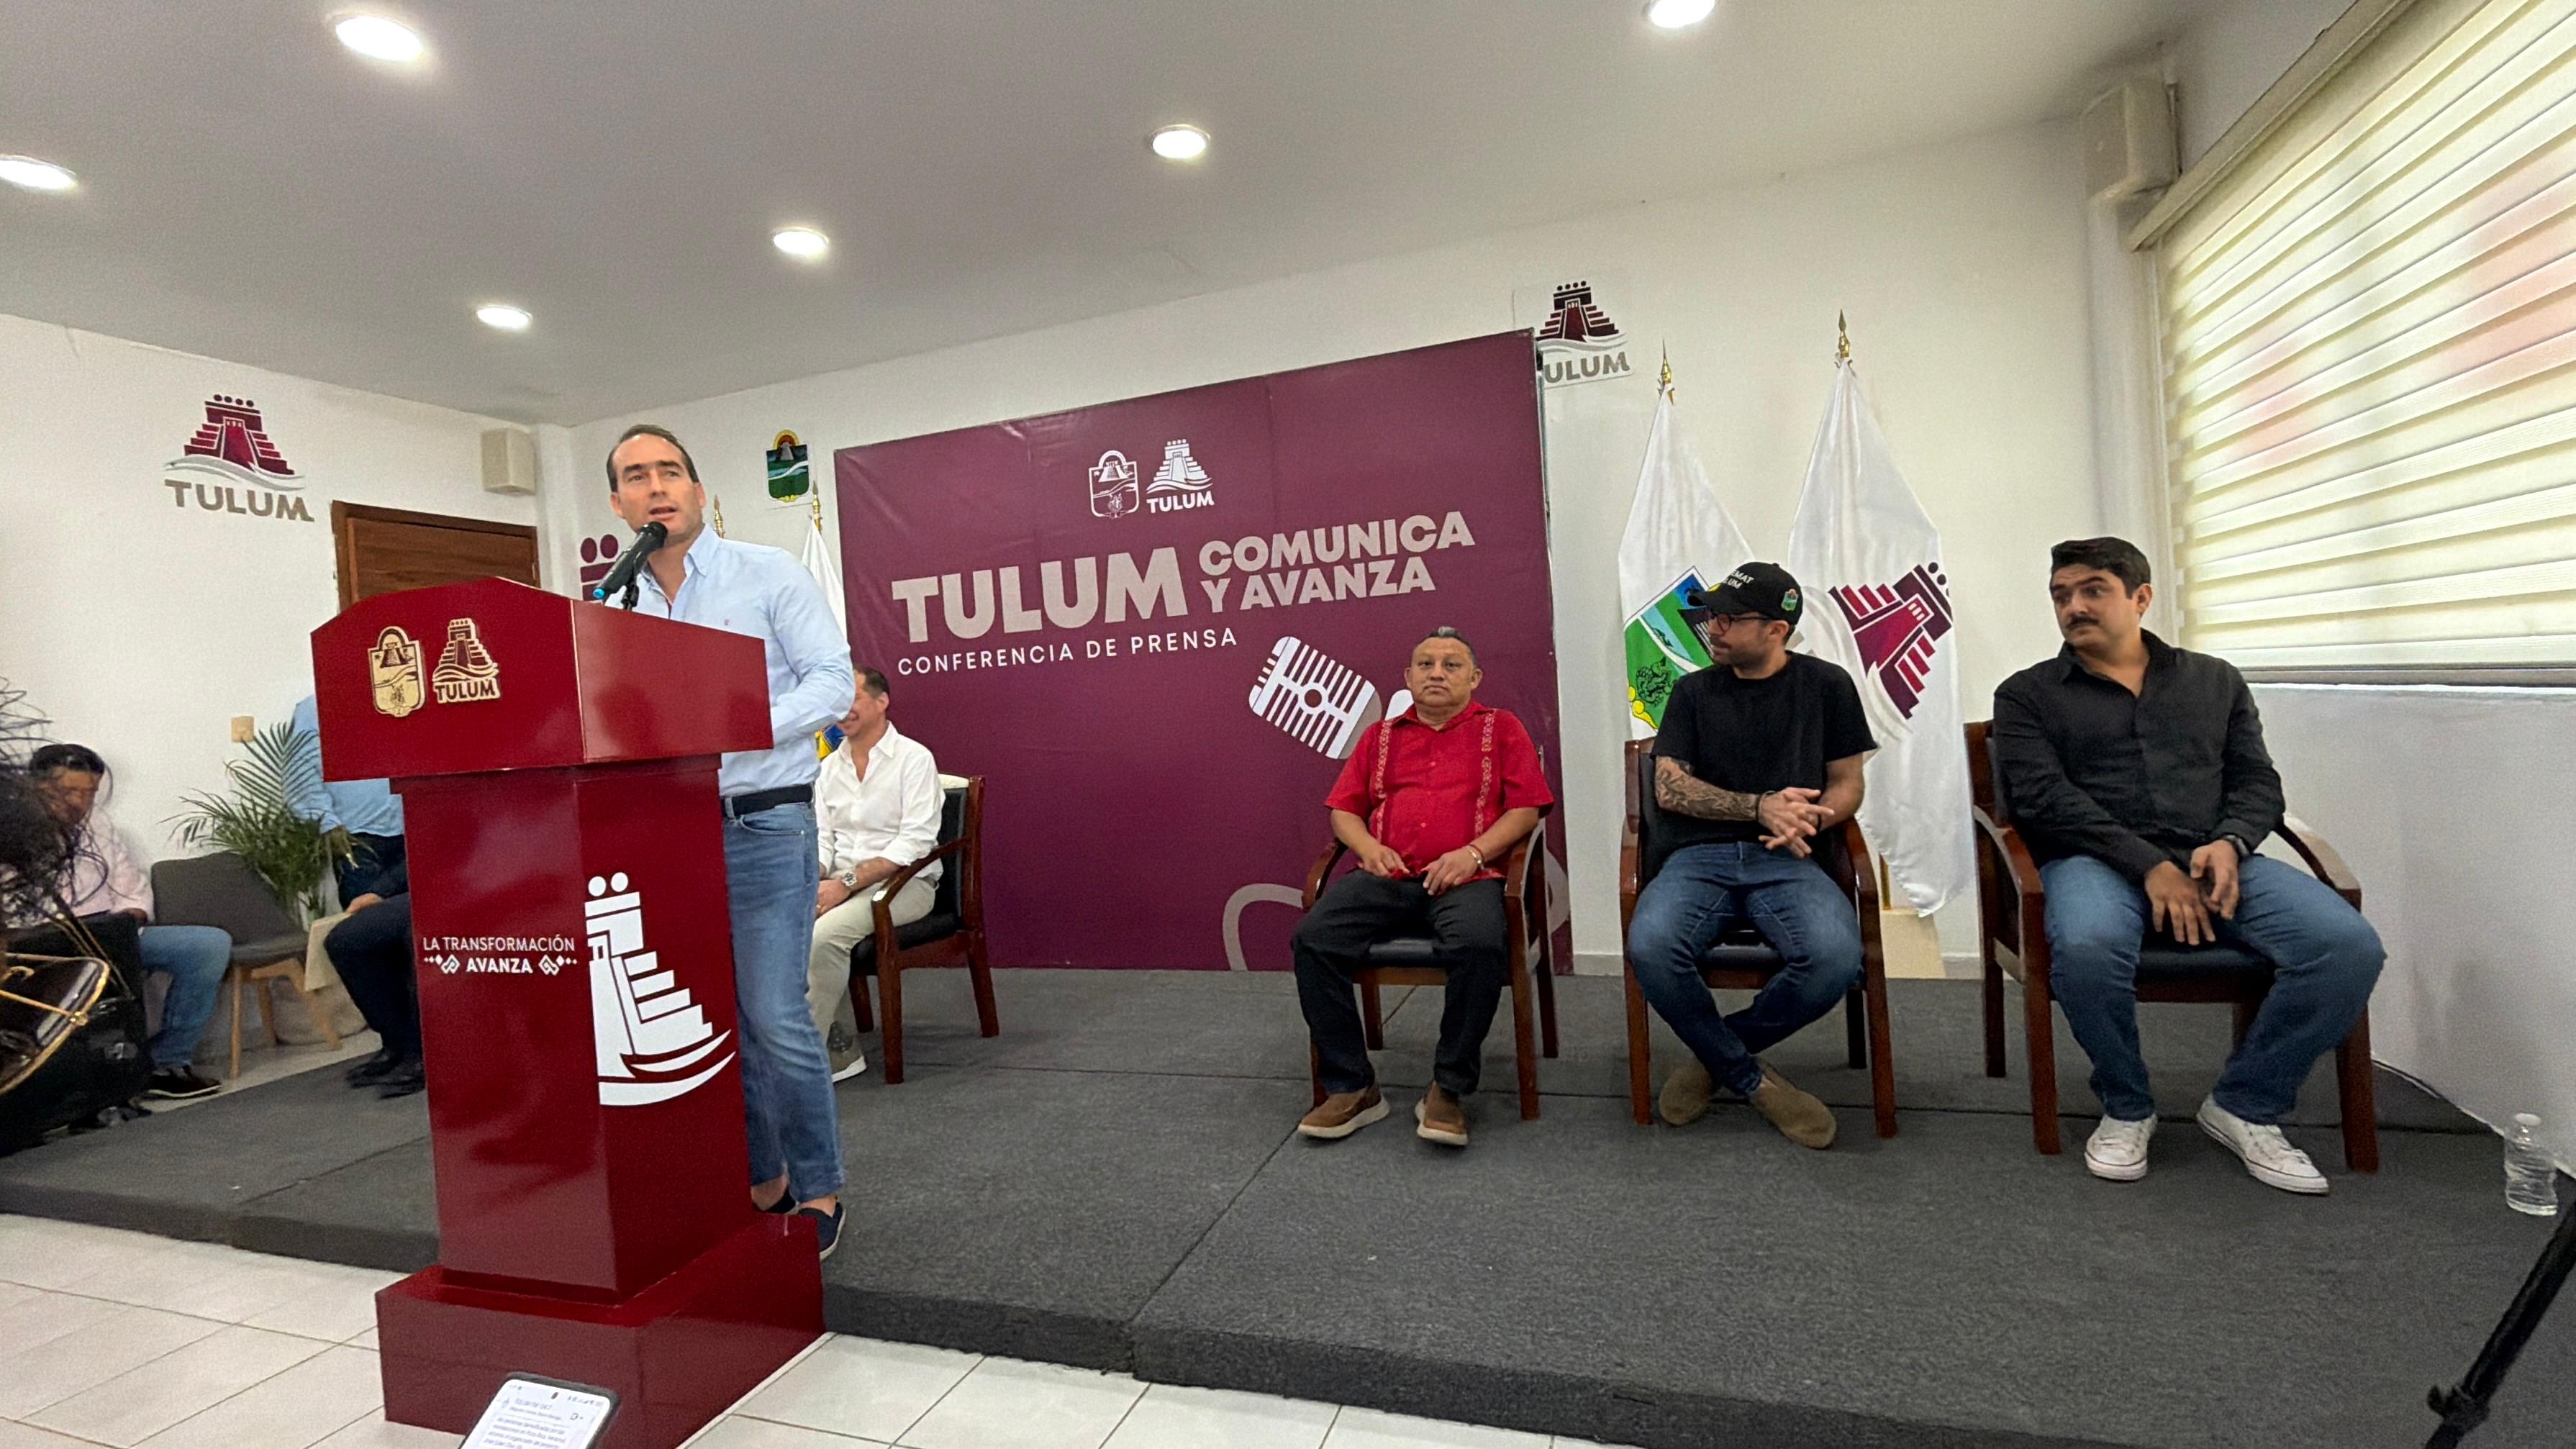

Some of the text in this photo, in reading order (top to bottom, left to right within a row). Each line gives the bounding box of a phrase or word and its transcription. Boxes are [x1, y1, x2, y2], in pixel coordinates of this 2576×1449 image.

[1543, 351, 1631, 383] ULUM
[164, 479, 315, 522] TULUM
[1146, 491, 1215, 514] TULUM
[1199, 511, 1476, 576] COMUNICA
[892, 547, 1188, 642] TULUM
[1200, 556, 1436, 613] Y AVANZA
[898, 627, 1237, 676] CONFERENCIA DE PRENSA
[435, 683, 496, 701] TULUM
[423, 934, 575, 952] LA TRANSFORMACIÓN
[466, 958, 533, 973] AVANZA
